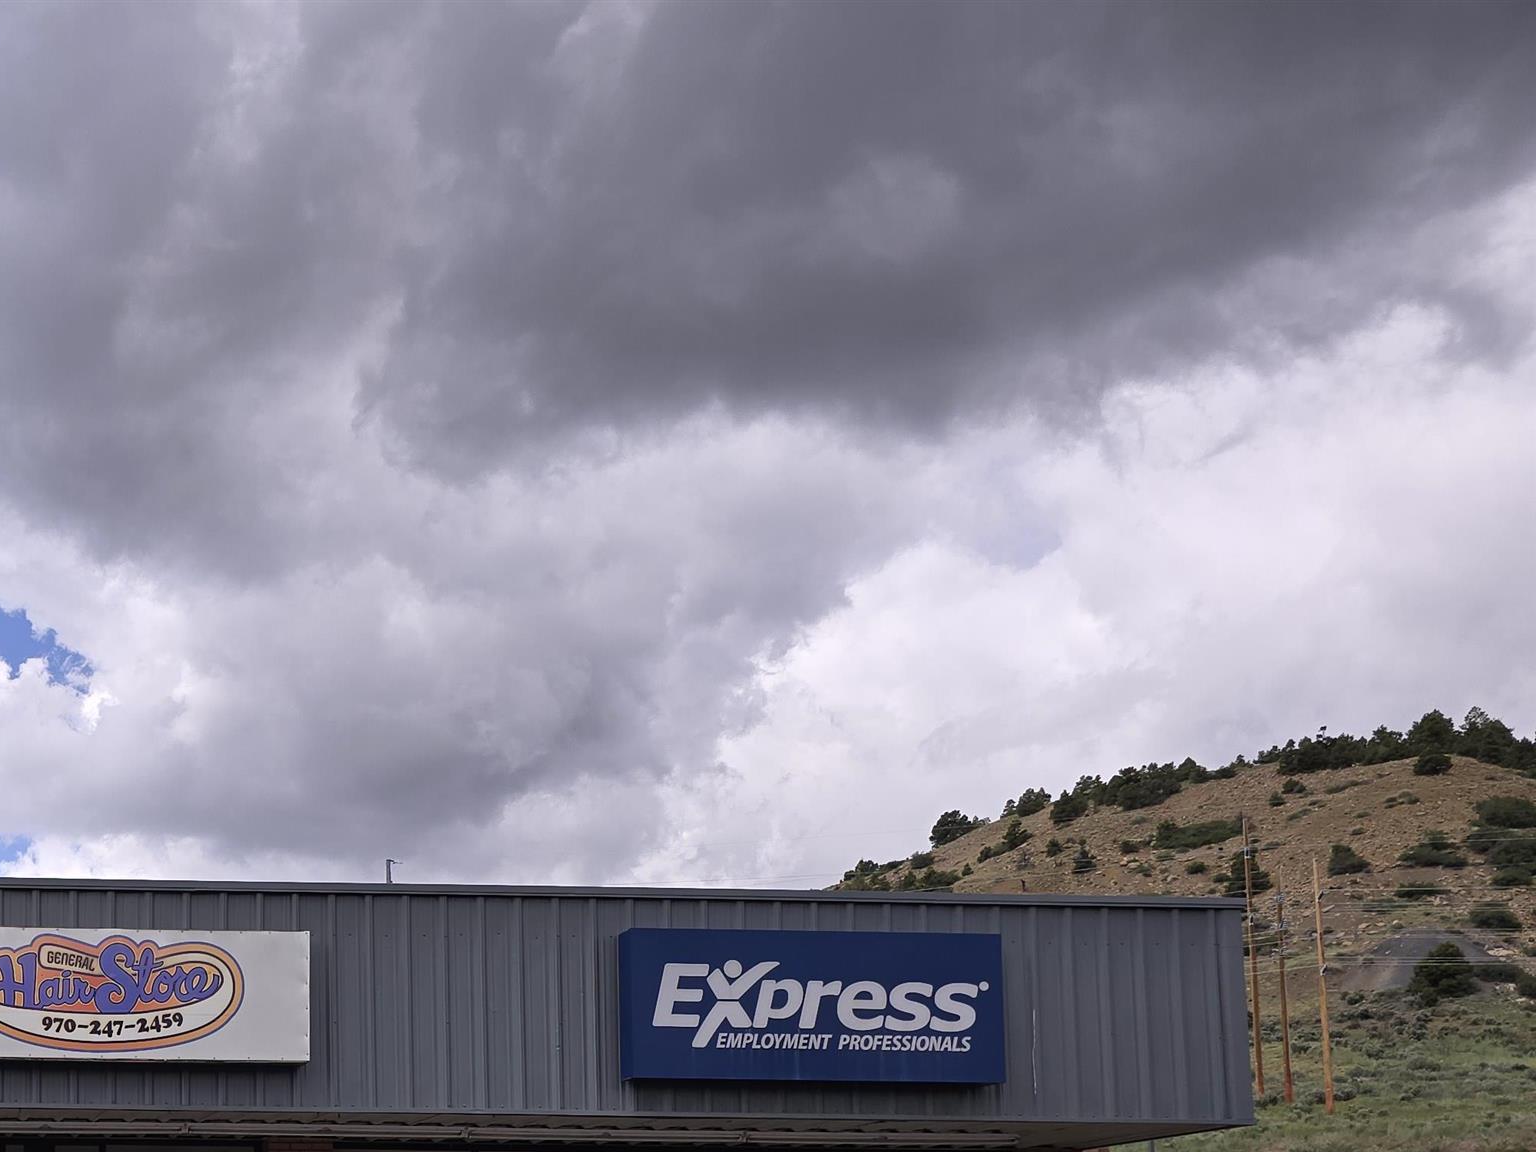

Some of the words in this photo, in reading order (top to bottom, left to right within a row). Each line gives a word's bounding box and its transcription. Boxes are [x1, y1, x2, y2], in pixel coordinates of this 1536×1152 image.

[47, 950, 95, 971] GENERAL
[95, 943, 223, 1014] Store
[41, 1012, 184, 1037] 970-247-2459
[716, 1032, 832, 1050] EMPLOYMENT
[838, 1034, 971, 1053] PROFESSIONALS
